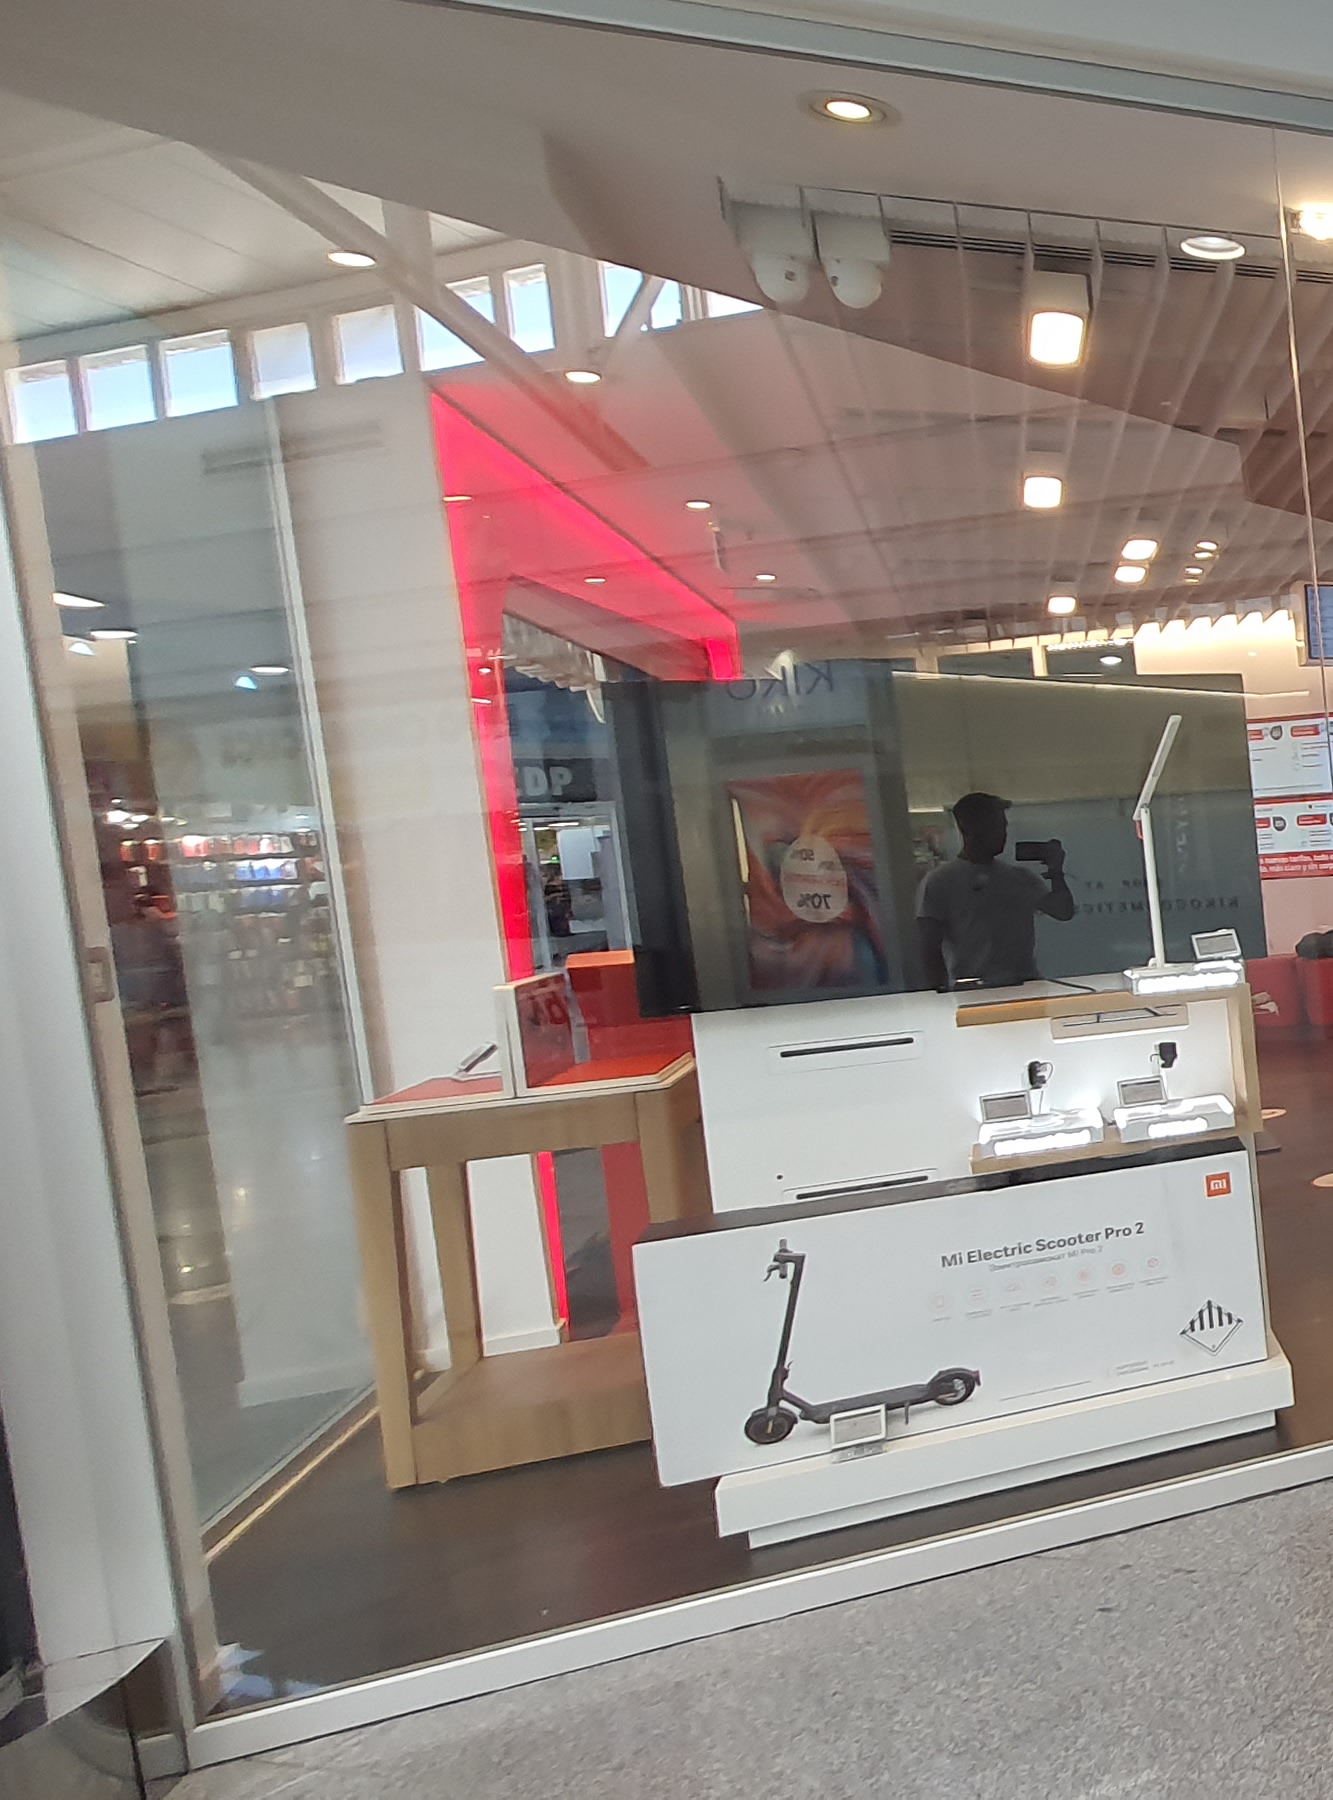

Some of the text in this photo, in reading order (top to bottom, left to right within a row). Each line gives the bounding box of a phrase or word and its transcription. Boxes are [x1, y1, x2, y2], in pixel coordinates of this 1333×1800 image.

[941, 1222, 1144, 1268] Mi Electric Scooter Pro 2
